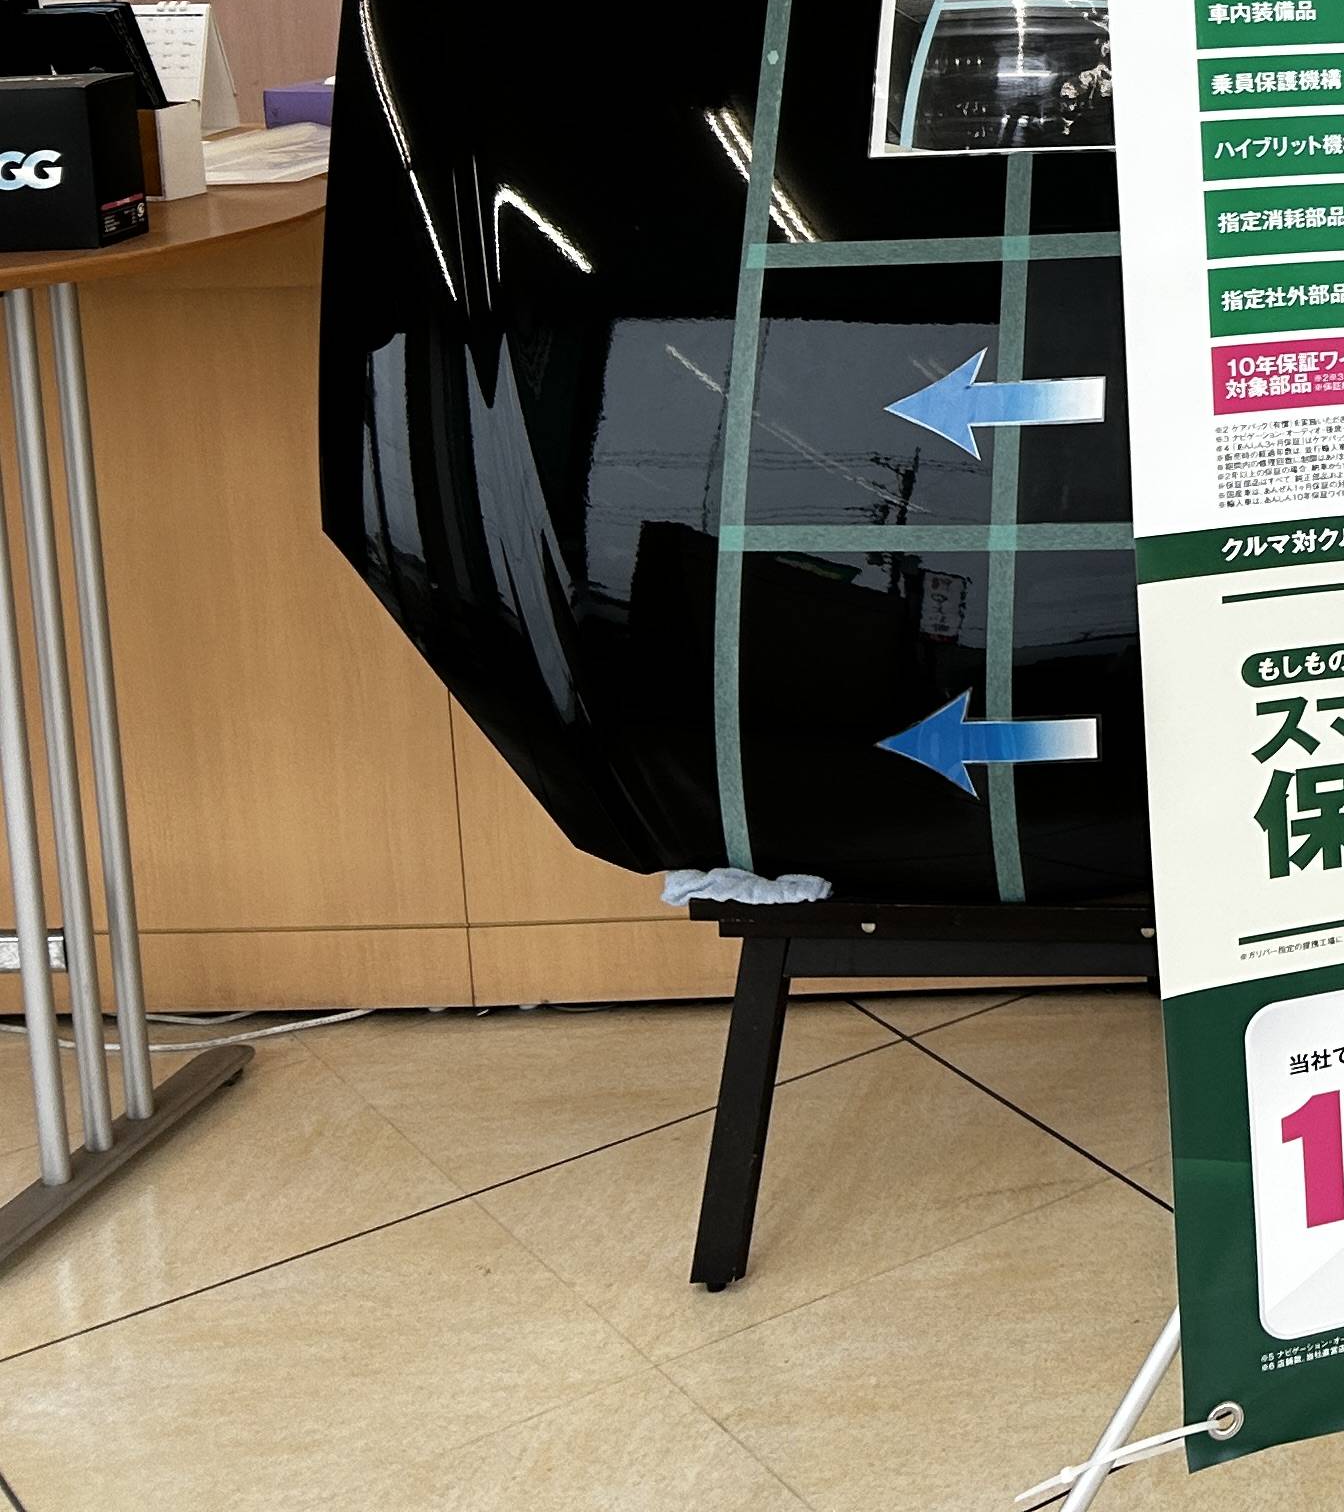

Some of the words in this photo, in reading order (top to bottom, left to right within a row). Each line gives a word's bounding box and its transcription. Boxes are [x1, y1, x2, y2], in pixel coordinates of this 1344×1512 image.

[1208, 0, 1317, 24] 車内装備品
[1211, 69, 1342, 95] 乗員保護機構
